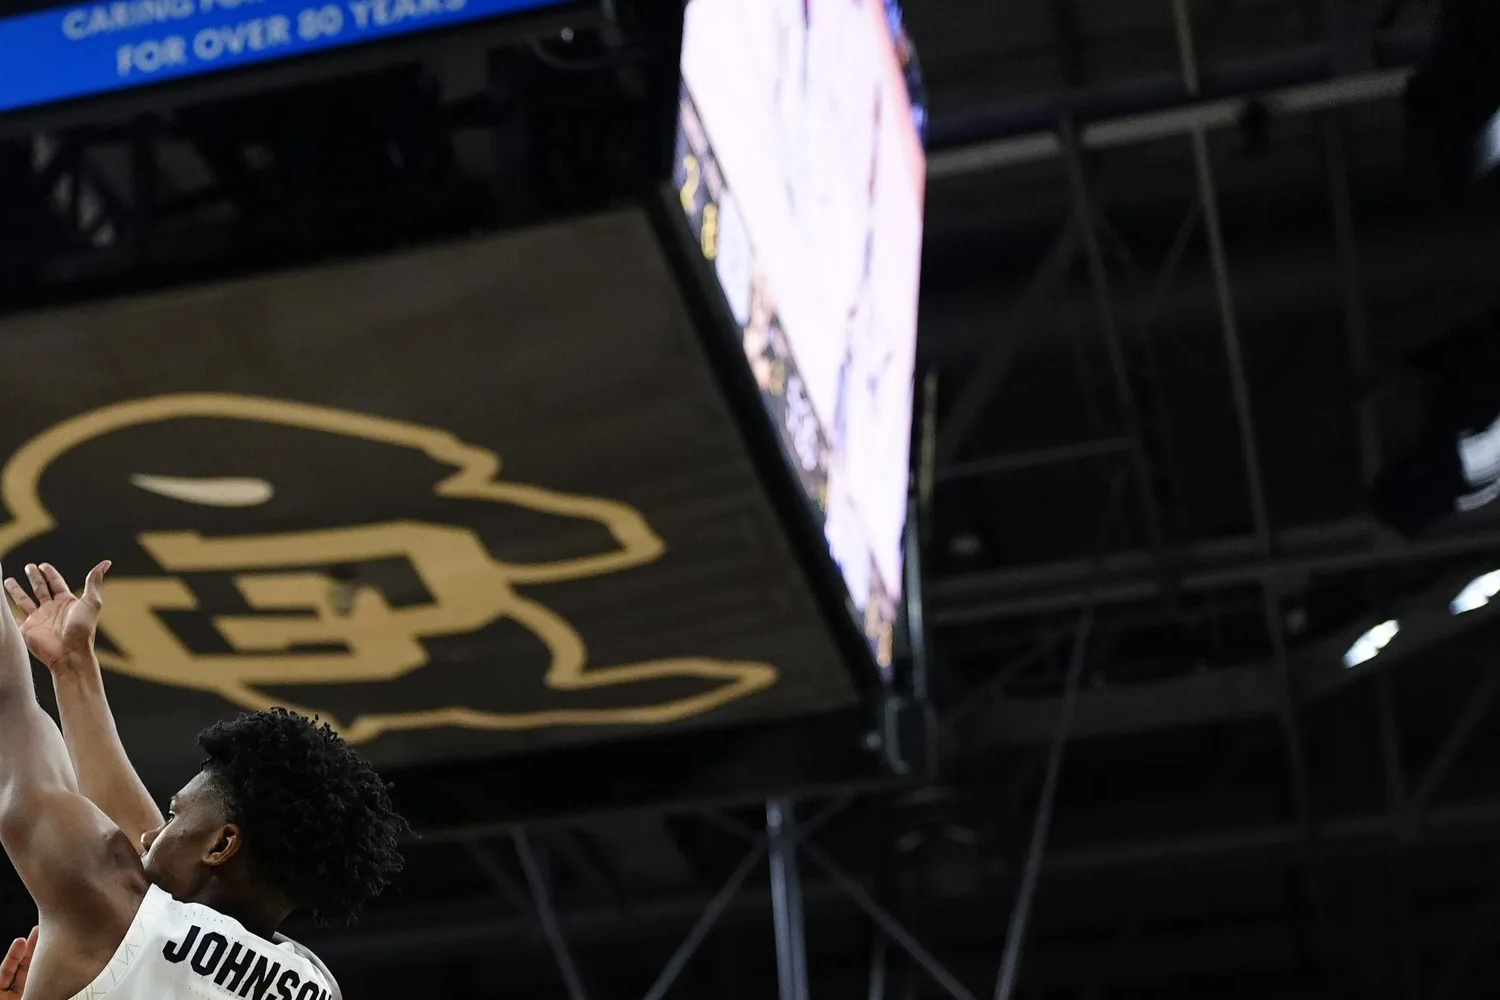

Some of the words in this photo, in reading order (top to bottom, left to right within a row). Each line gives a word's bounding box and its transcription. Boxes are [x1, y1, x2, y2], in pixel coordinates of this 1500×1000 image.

[62, 0, 195, 40] CARING
[116, 34, 188, 77] FOR
[193, 14, 290, 60] OVER
[297, 5, 344, 40] 80
